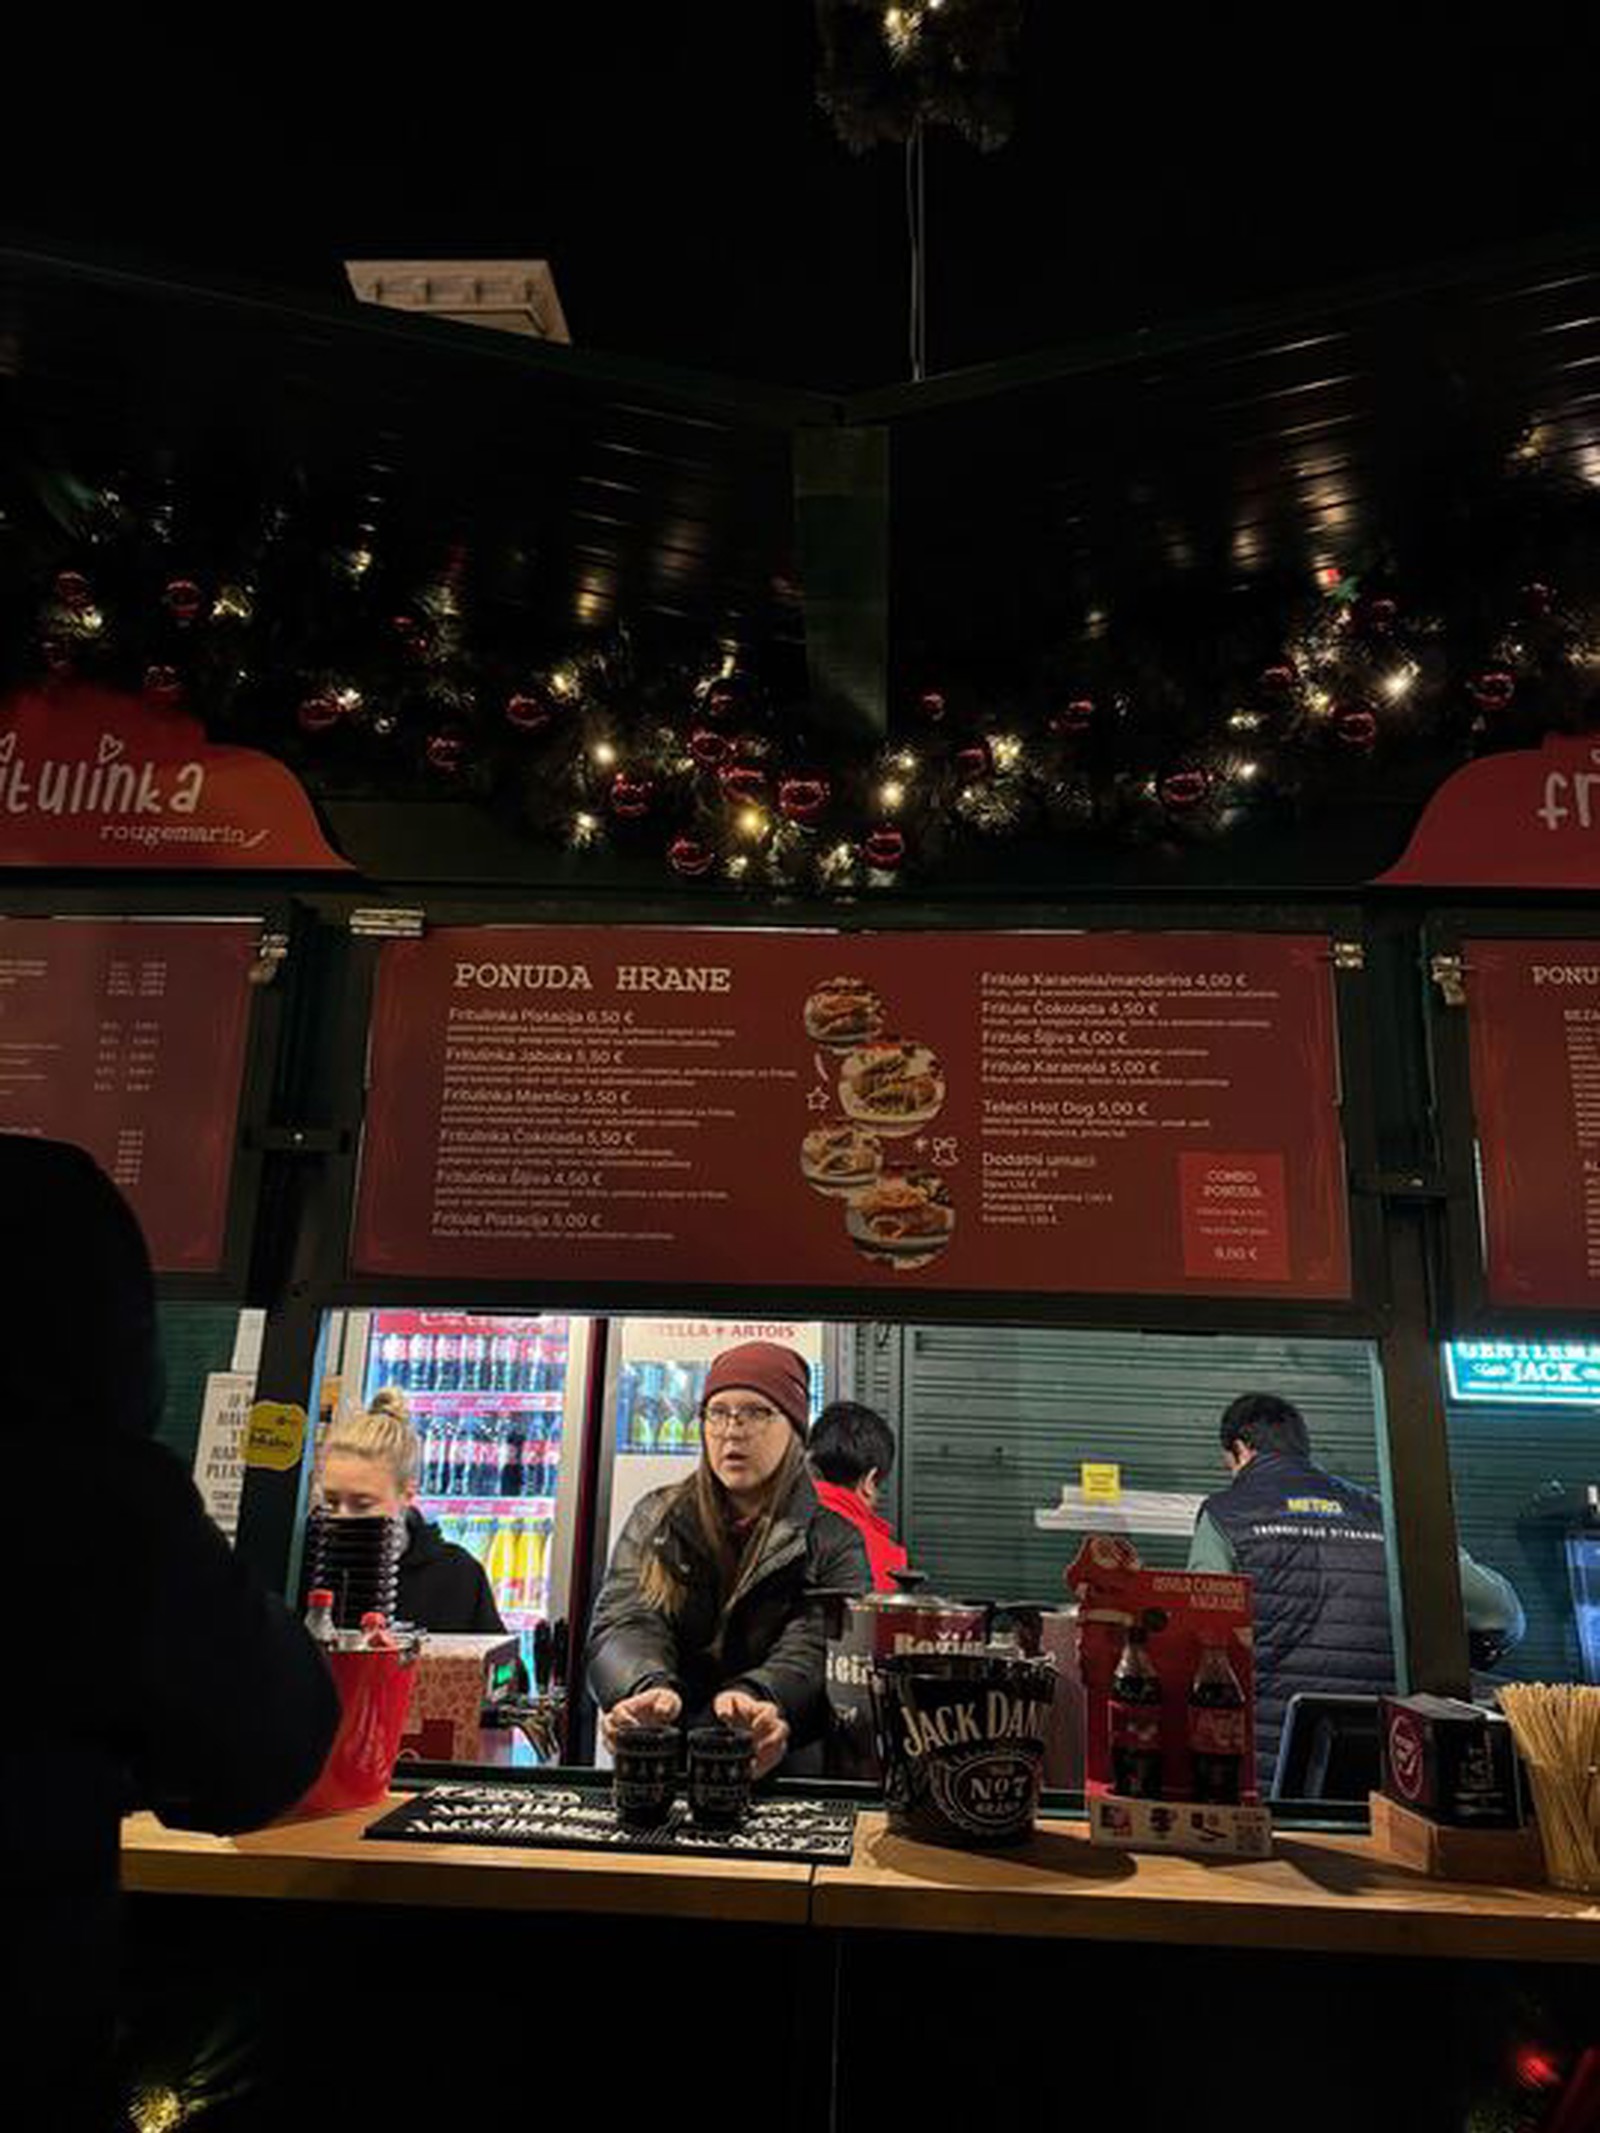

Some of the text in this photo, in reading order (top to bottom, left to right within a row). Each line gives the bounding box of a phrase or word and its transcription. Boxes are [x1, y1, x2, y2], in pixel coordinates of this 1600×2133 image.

[453, 962, 732, 993] PONUDA HRANE
[1031, 1100, 1060, 1115] Hot
[1062, 1101, 1096, 1118] Dog
[1098, 1101, 1134, 1117] 5,00
[731, 1324, 796, 1339] ARTOIS
[1511, 1359, 1584, 1384] JACK
[900, 1699, 982, 1757] JACK
